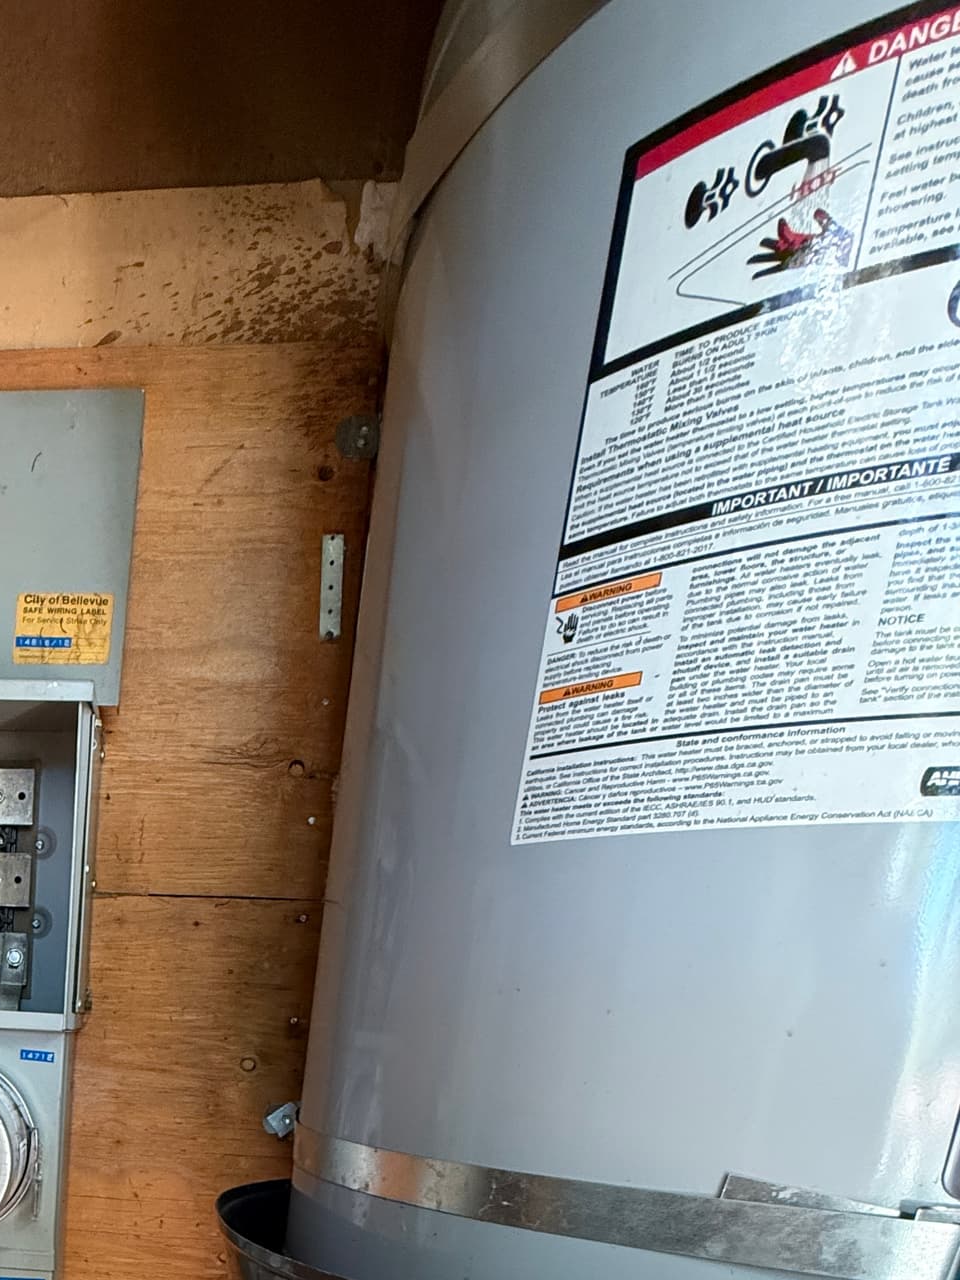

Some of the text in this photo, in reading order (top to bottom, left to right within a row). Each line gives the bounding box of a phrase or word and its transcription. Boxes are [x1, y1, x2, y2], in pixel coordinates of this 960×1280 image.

[902, 83, 938, 102] death
[897, 101, 955, 126] Children,
[909, 113, 958, 135] highest
[911, 177, 946, 193] water
[874, 212, 951, 238] Temperature
[713, 325, 757, 345] PRODUCE
[607, 427, 667, 453] Thermostatic
[669, 416, 702, 431] Mixing
[706, 405, 739, 419] Valves
[703, 423, 775, 450] supplemental
[778, 417, 803, 429] heat
[805, 409, 845, 423] source
[711, 481, 814, 517] IMPORTANT
[826, 457, 952, 491] IMPORTANTE
[822, 540, 837, 548] the
[841, 534, 880, 546] adjacent
[24, 594, 109, 606] City of Bellevue
[589, 583, 633, 600] WARNING
[23, 606, 107, 616] SAFE WIRING LABEL
[878, 613, 926, 627] NOTICE
[768, 629, 788, 638] your
[791, 625, 816, 633] water
[820, 621, 848, 629] heater
[571, 680, 614, 694] WARNING
[568, 695, 599, 709] against
[602, 690, 625, 701] leaks
[676, 726, 846, 747] State and conformance information
[716, 814, 748, 823] National
[750, 814, 789, 823] Appliance
[790, 813, 820, 821] Energy
[821, 810, 876, 819] Conservation
